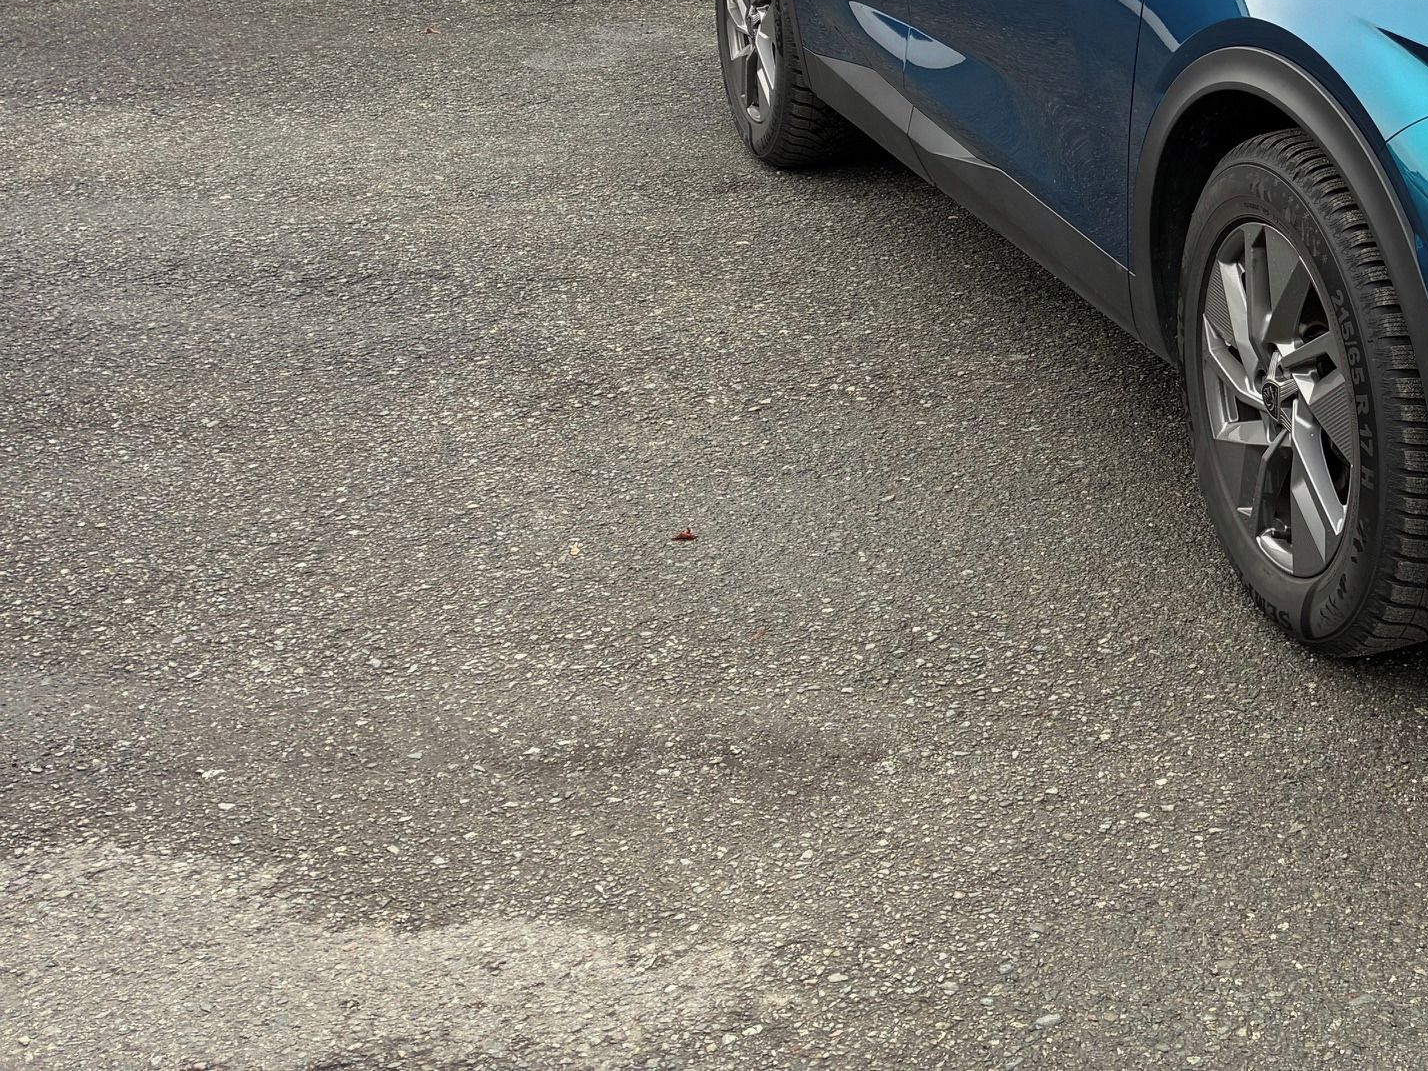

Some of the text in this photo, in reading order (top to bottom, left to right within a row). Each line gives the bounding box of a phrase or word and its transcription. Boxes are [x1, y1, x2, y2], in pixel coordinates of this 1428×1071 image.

[1330, 289, 1365, 386] 215/65
[1356, 394, 1370, 416] R
[1359, 424, 1374, 458] 17
